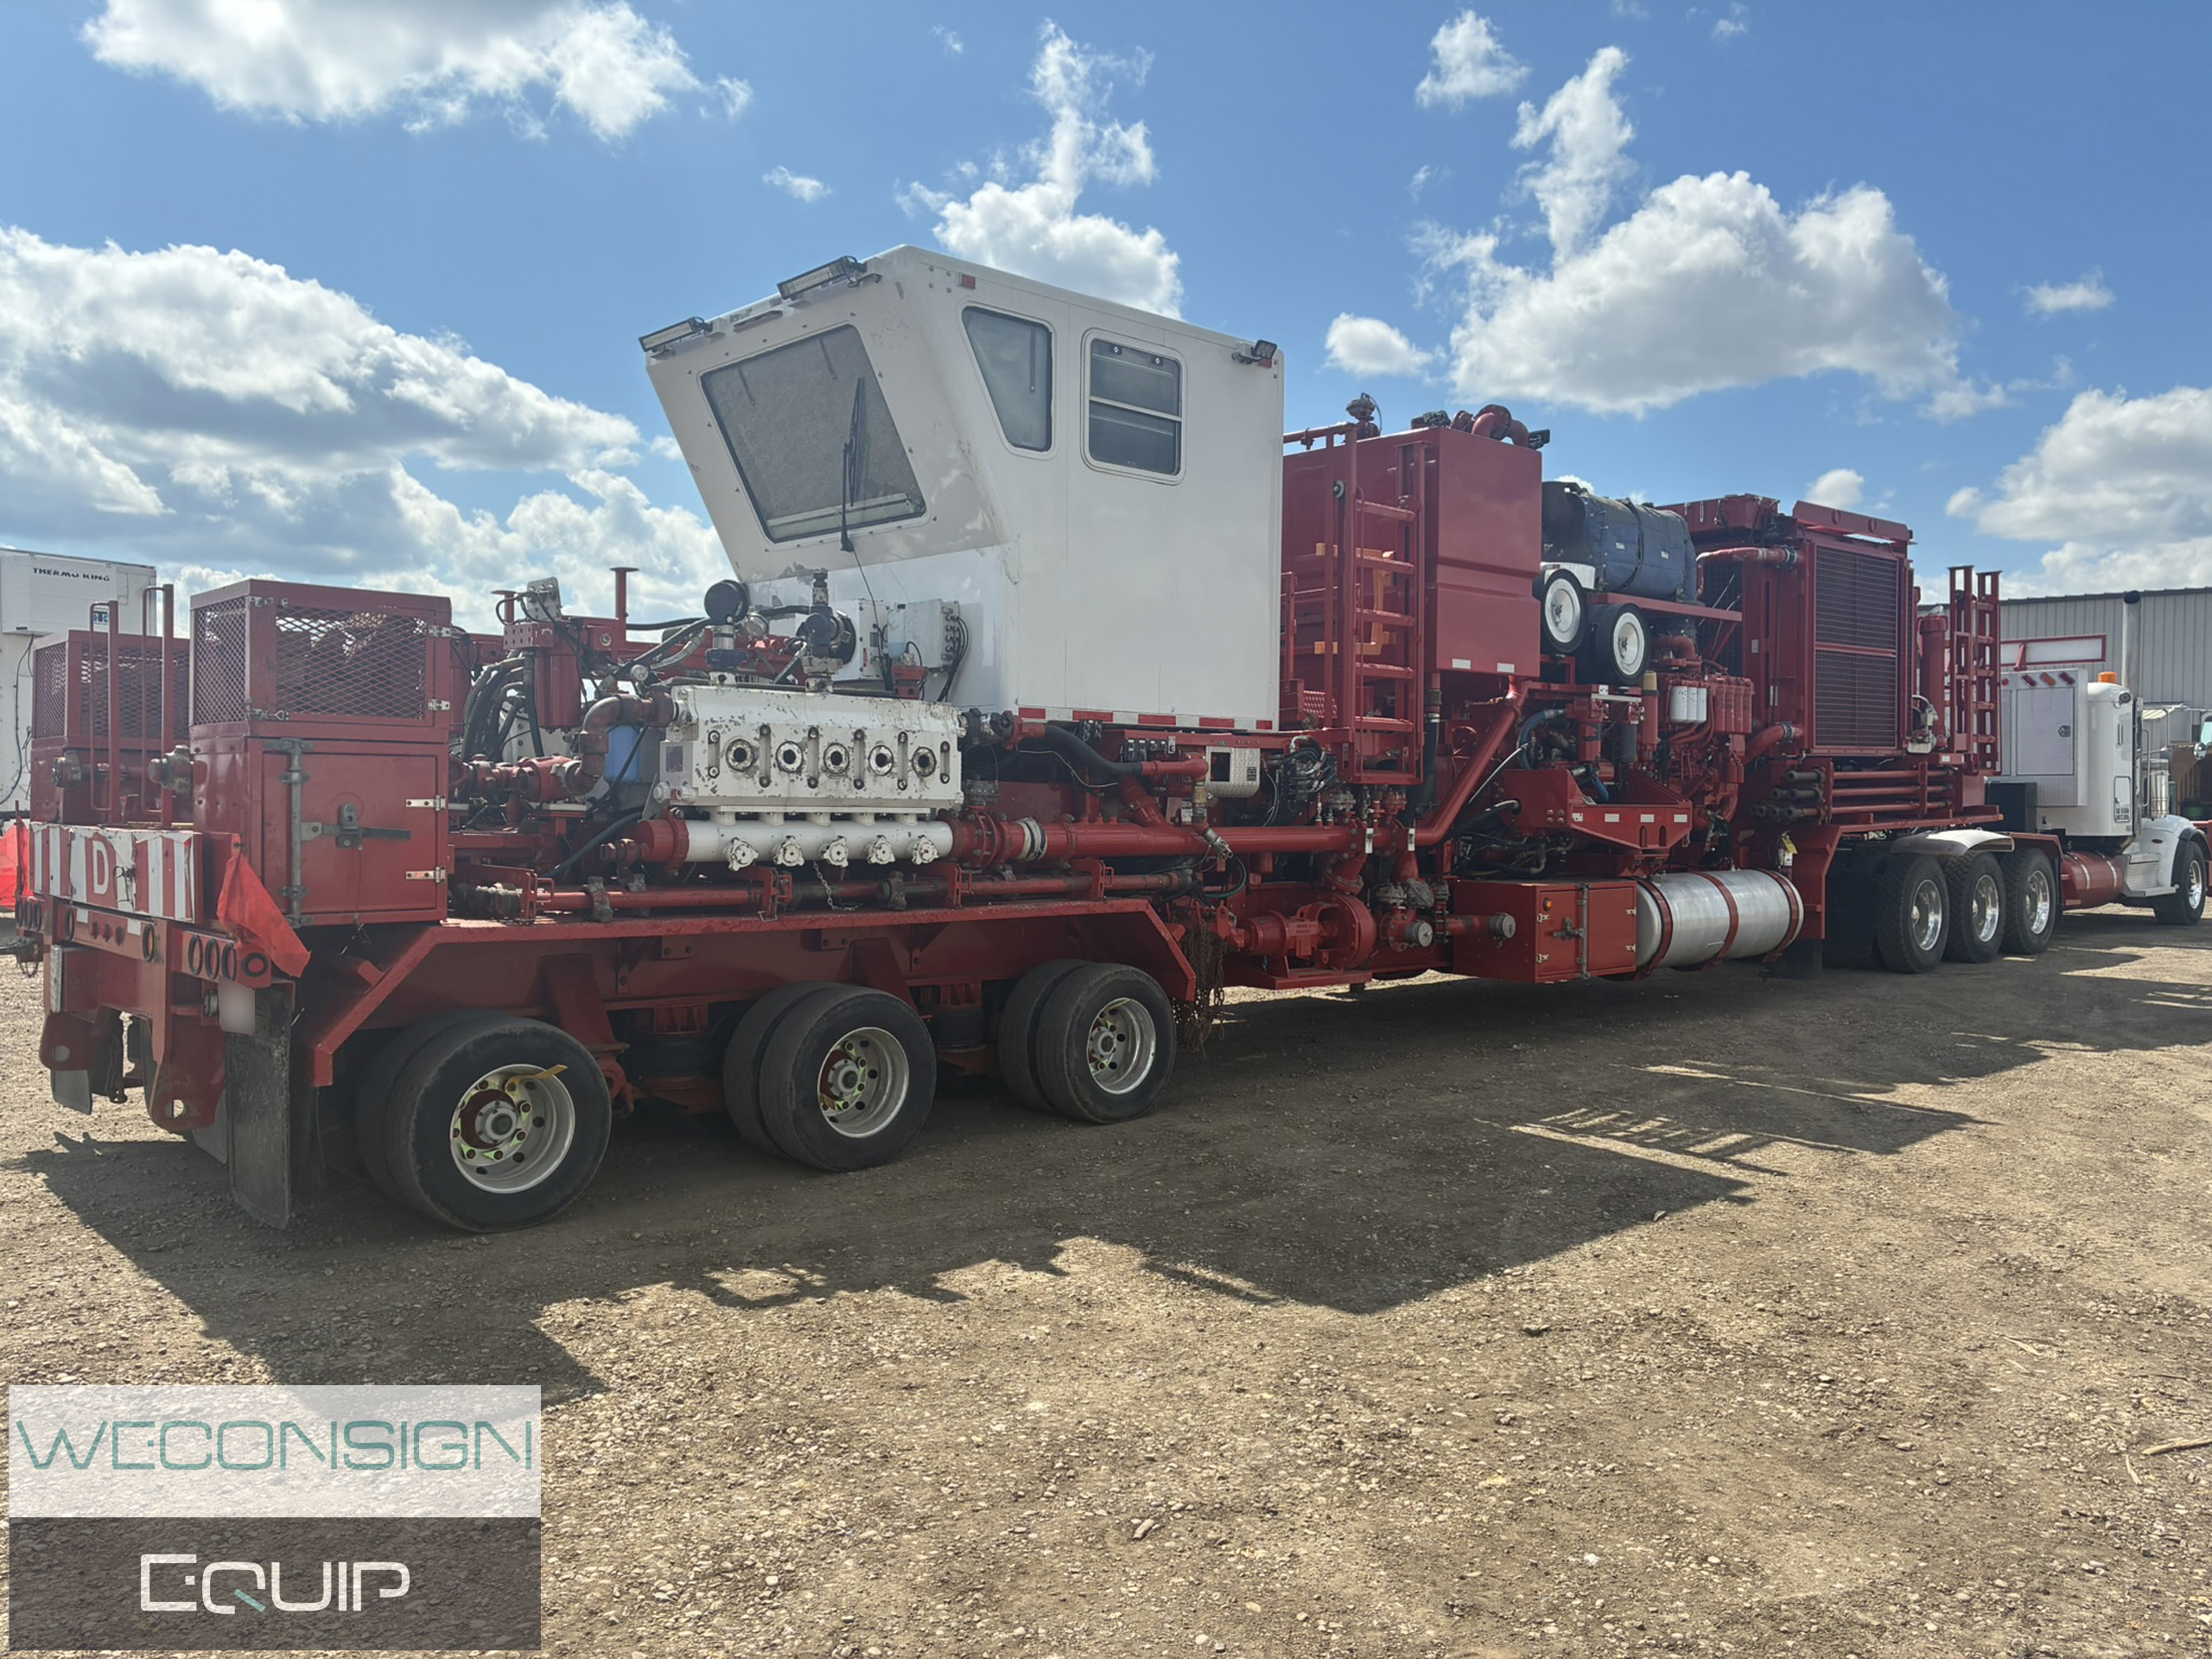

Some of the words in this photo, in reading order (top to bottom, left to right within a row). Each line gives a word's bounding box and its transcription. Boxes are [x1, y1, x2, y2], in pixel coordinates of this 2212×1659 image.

[33, 568, 79, 578] THERMO
[83, 573, 111, 582] KING
[92, 840, 109, 894] D
